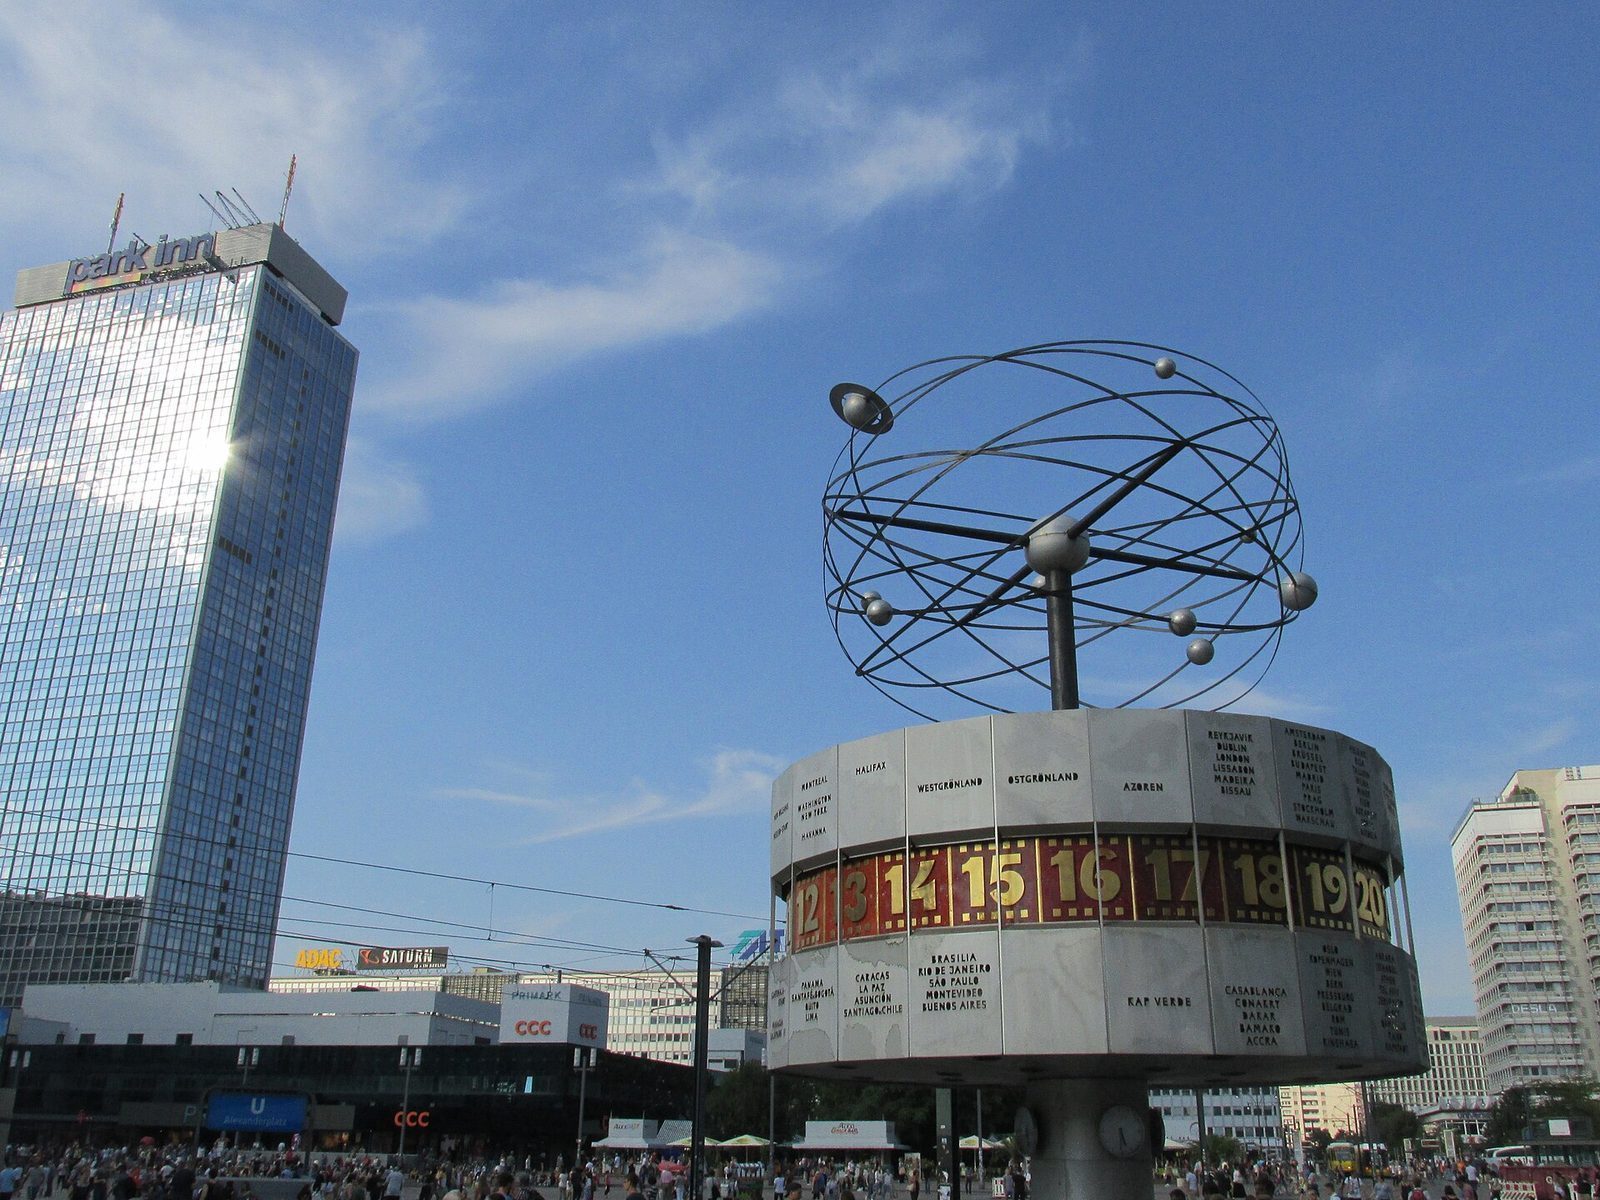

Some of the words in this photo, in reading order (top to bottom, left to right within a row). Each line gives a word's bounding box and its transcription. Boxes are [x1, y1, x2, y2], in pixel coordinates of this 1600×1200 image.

[65, 241, 148, 296] park
[154, 233, 214, 267] inn
[1208, 730, 1254, 743] REYKJAVIK
[1284, 727, 1326, 741] AMSTERDAM
[1217, 742, 1247, 752] DUBLIN
[1294, 739, 1319, 751] BERLIN
[1216, 753, 1250, 763] LONDON
[855, 761, 887, 775] HALIFAX
[1291, 759, 1327, 774] BUDAPEST
[1008, 772, 1079, 785] OSTGRÖNLAND
[1214, 774, 1256, 785] MADEIRA
[1295, 771, 1324, 783] MADRID
[917, 778, 983, 793] WESTGRÖNLAND
[1123, 782, 1164, 792] AZOREN
[1221, 785, 1251, 796] BISSAU
[1302, 783, 1321, 794] PARIS
[1293, 802, 1334, 817] STOCKHOLM
[961, 852, 1025, 908] 15
[1051, 848, 1121, 902] 16
[1145, 849, 1210, 901] 17
[1233, 854, 1288, 909] 18
[884, 860, 936, 915] 14
[1305, 862, 1347, 914] 19
[830, 871, 867, 924] 13
[1355, 871, 1386, 928] 20
[797, 884, 819, 935] 12
[295, 948, 342, 968] ADAC
[382, 949, 432, 964] SATURN
[931, 953, 977, 964] BRASILIA
[918, 967, 932, 976] RIO
[935, 966, 945, 975] DE
[949, 964, 991, 974] JANEIRO
[855, 971, 890, 983] CARACAS
[950, 976, 979, 986] PAULO
[859, 985, 869, 994] LA
[871, 983, 885, 992] PAZ
[926, 988, 983, 1000] MONTEVIDEO
[511, 991, 562, 1000] PRIMARK
[854, 993, 892, 1006] ASUNCIÓN
[1127, 997, 1149, 1007] KAP
[1154, 997, 1192, 1007] VERDE
[922, 1001, 957, 1012] BUENOS
[959, 1000, 987, 1010] AIRES
[1235, 999, 1280, 1010] CONAKRY
[515, 1020, 552, 1036] CCC
[1240, 1024, 1281, 1034] BAMAKO
[1246, 1036, 1278, 1046] ACCRA
[251, 1097, 266, 1114] U
[223, 1116, 288, 1128] Alexanderplatz
[394, 1111, 430, 1127] CCC
